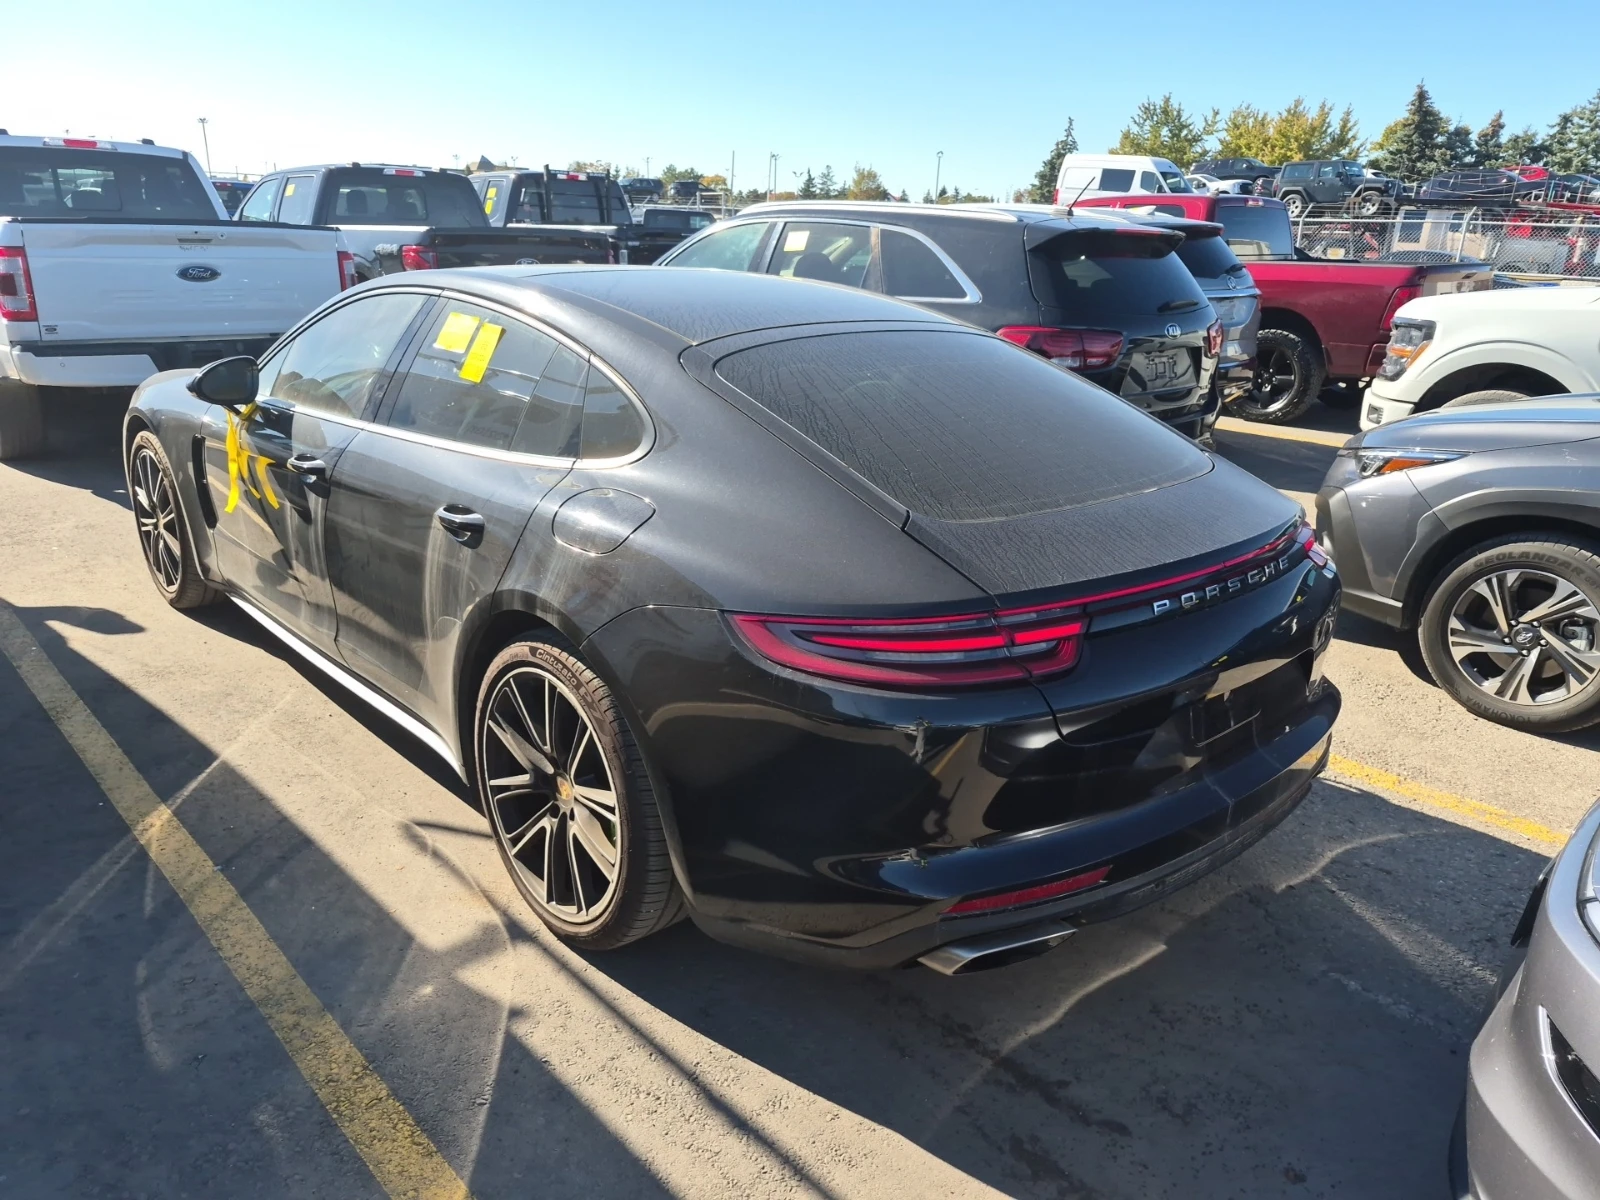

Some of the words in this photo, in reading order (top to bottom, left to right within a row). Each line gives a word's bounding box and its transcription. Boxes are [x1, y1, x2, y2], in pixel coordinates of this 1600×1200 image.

[1167, 325, 1181, 337] KIA
[1473, 551, 1586, 577] GEOLANDAR
[1153, 555, 1289, 616] PORSCHE
[535, 648, 578, 686] Cinturato
[578, 686, 605, 721] P7
[1466, 695, 1532, 722] YOKOHAMA
